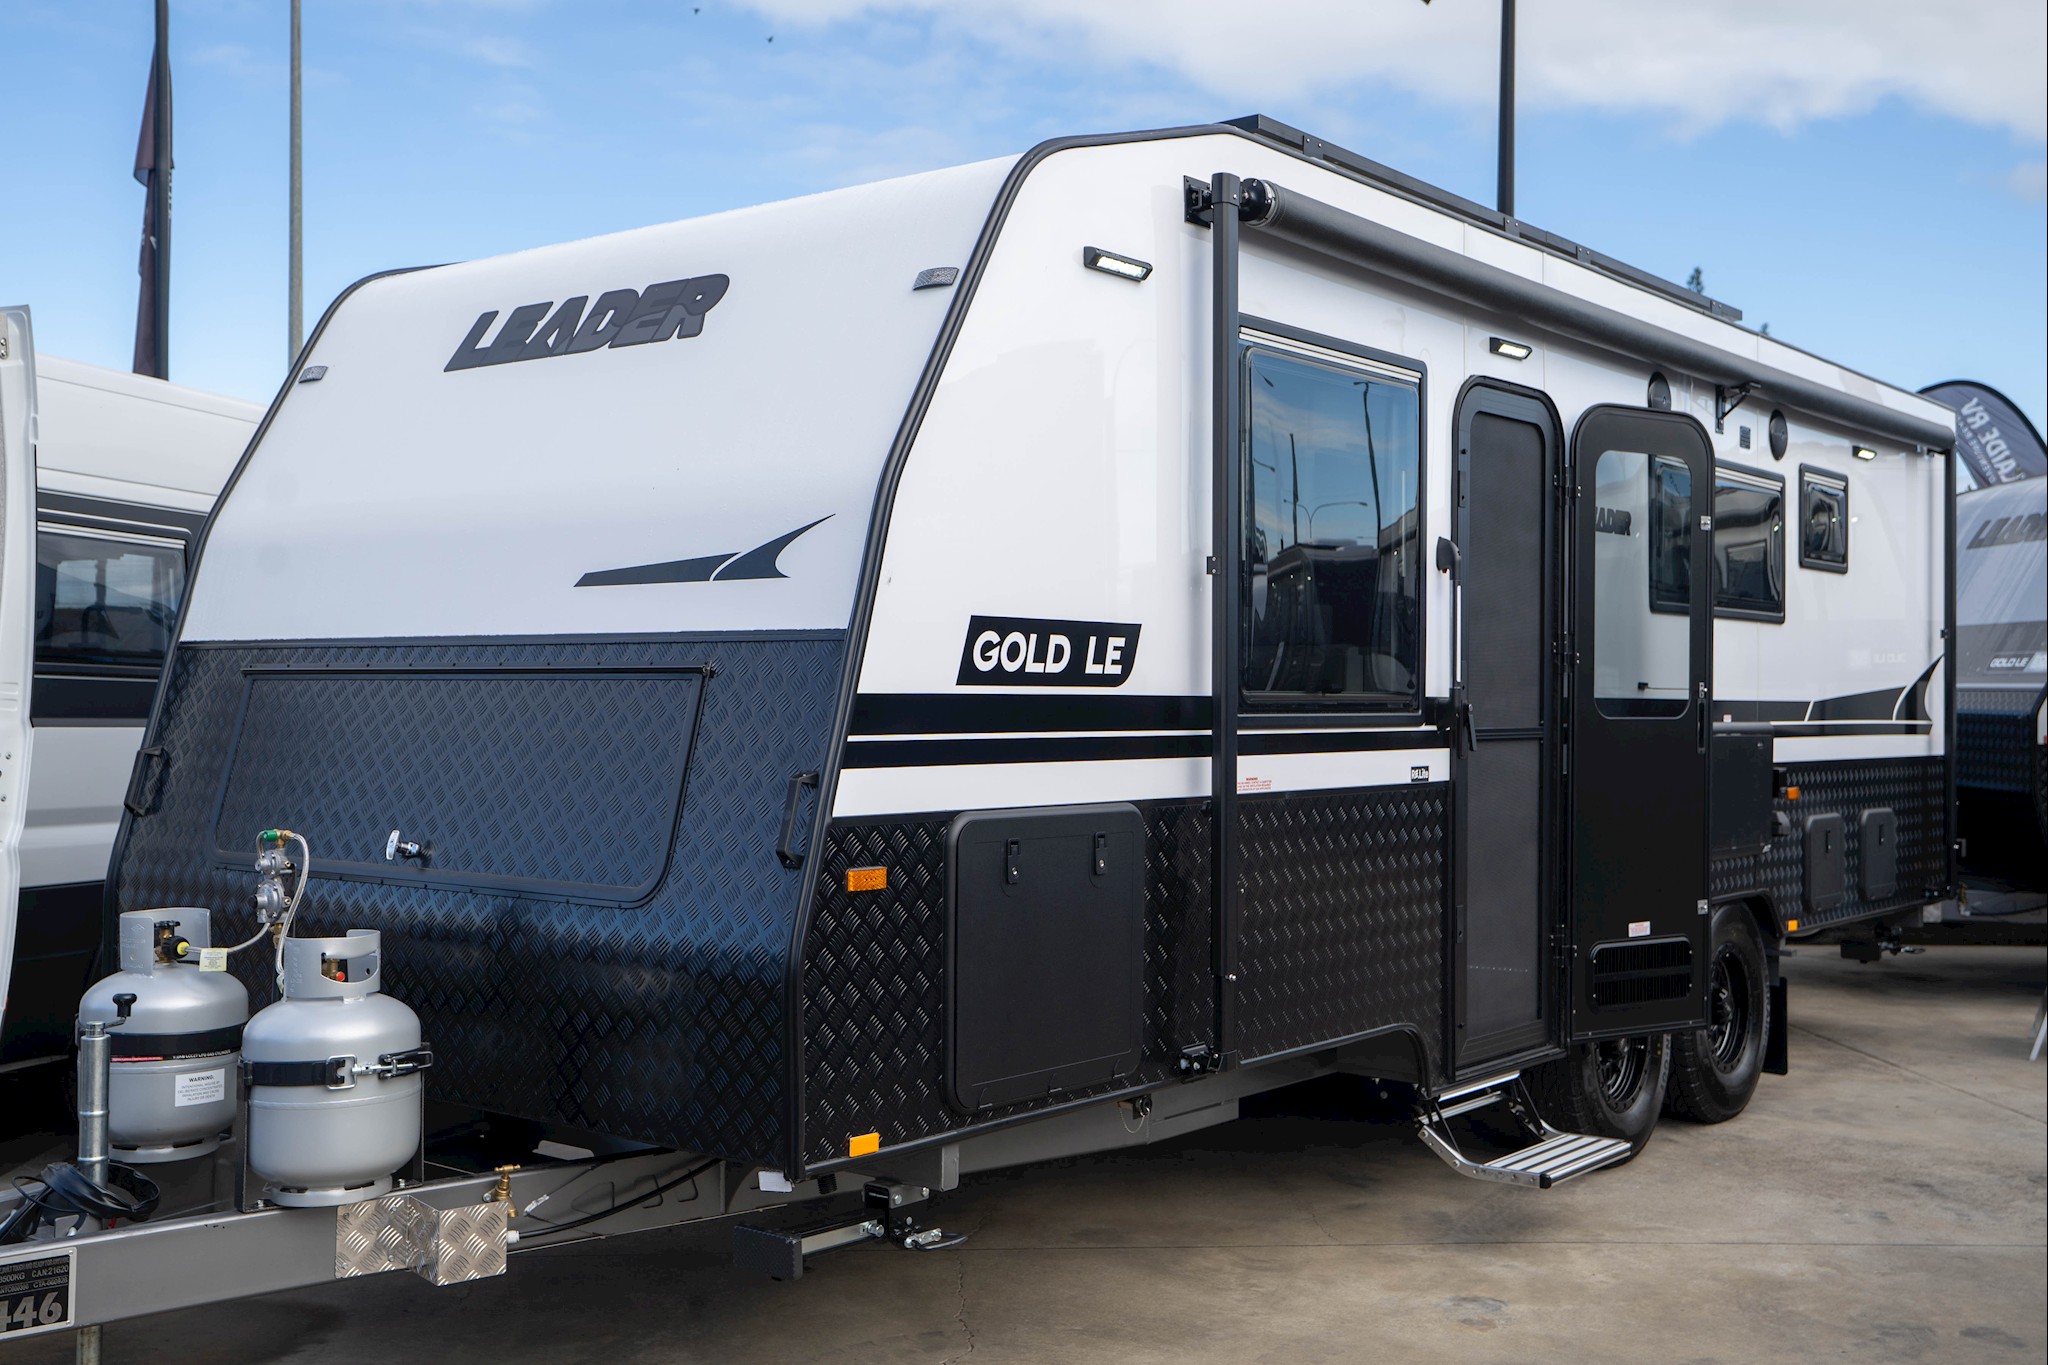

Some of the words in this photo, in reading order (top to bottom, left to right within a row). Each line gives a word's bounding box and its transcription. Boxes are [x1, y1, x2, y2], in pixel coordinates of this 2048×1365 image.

[444, 273, 730, 373] LEADER
[973, 630, 1071, 673] GOLD
[1085, 636, 1126, 675] LE
